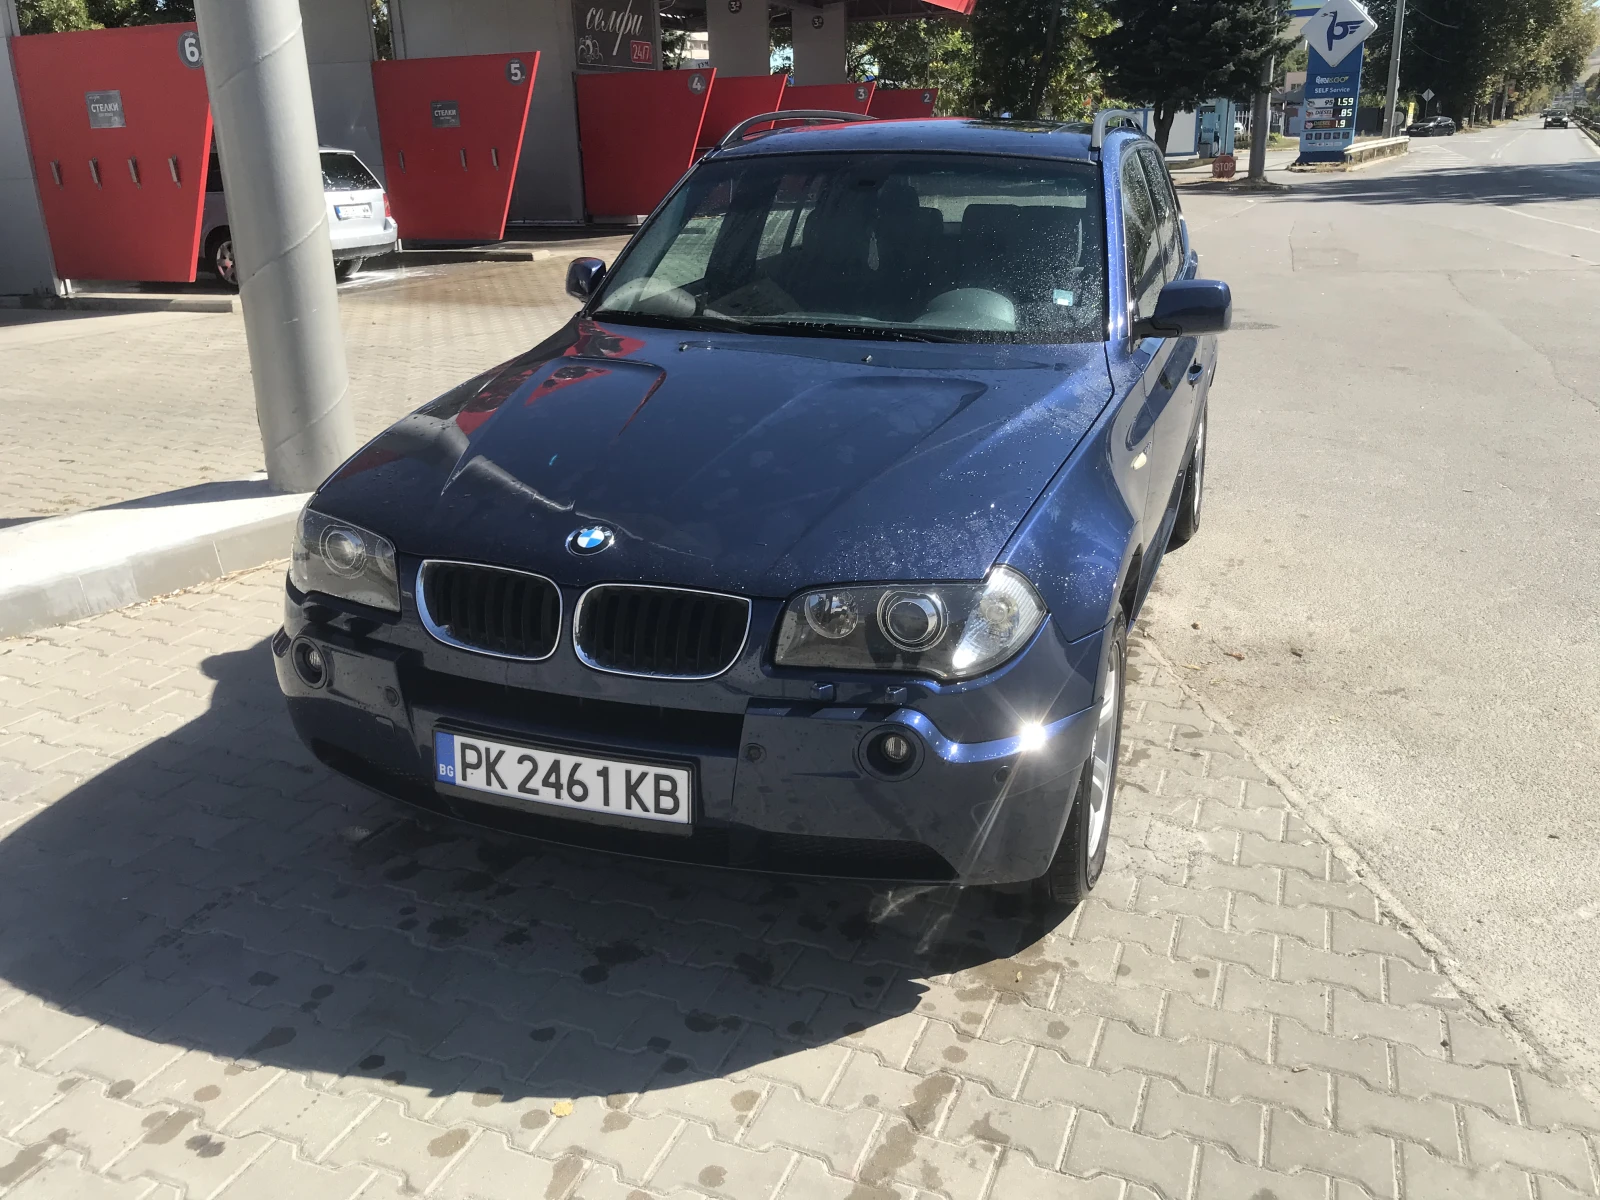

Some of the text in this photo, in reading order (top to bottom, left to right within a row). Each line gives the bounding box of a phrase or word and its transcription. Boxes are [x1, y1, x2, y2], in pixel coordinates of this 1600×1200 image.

[184, 37, 200, 62] 6
[632, 44, 650, 60] 24/7
[510, 63, 522, 81] 5
[692, 77, 702, 91] 4
[857, 88, 865, 99] 3
[923, 93, 931, 103] 2
[91, 102, 119, 113] СТЕЛКИ
[1337, 97, 1354, 106] 1.59
[434, 109, 457, 117] СТЕЛКИ
[1215, 162, 1234, 172] STOP
[439, 764, 454, 778] BG
[460, 742, 680, 816] PK 2461 KB
